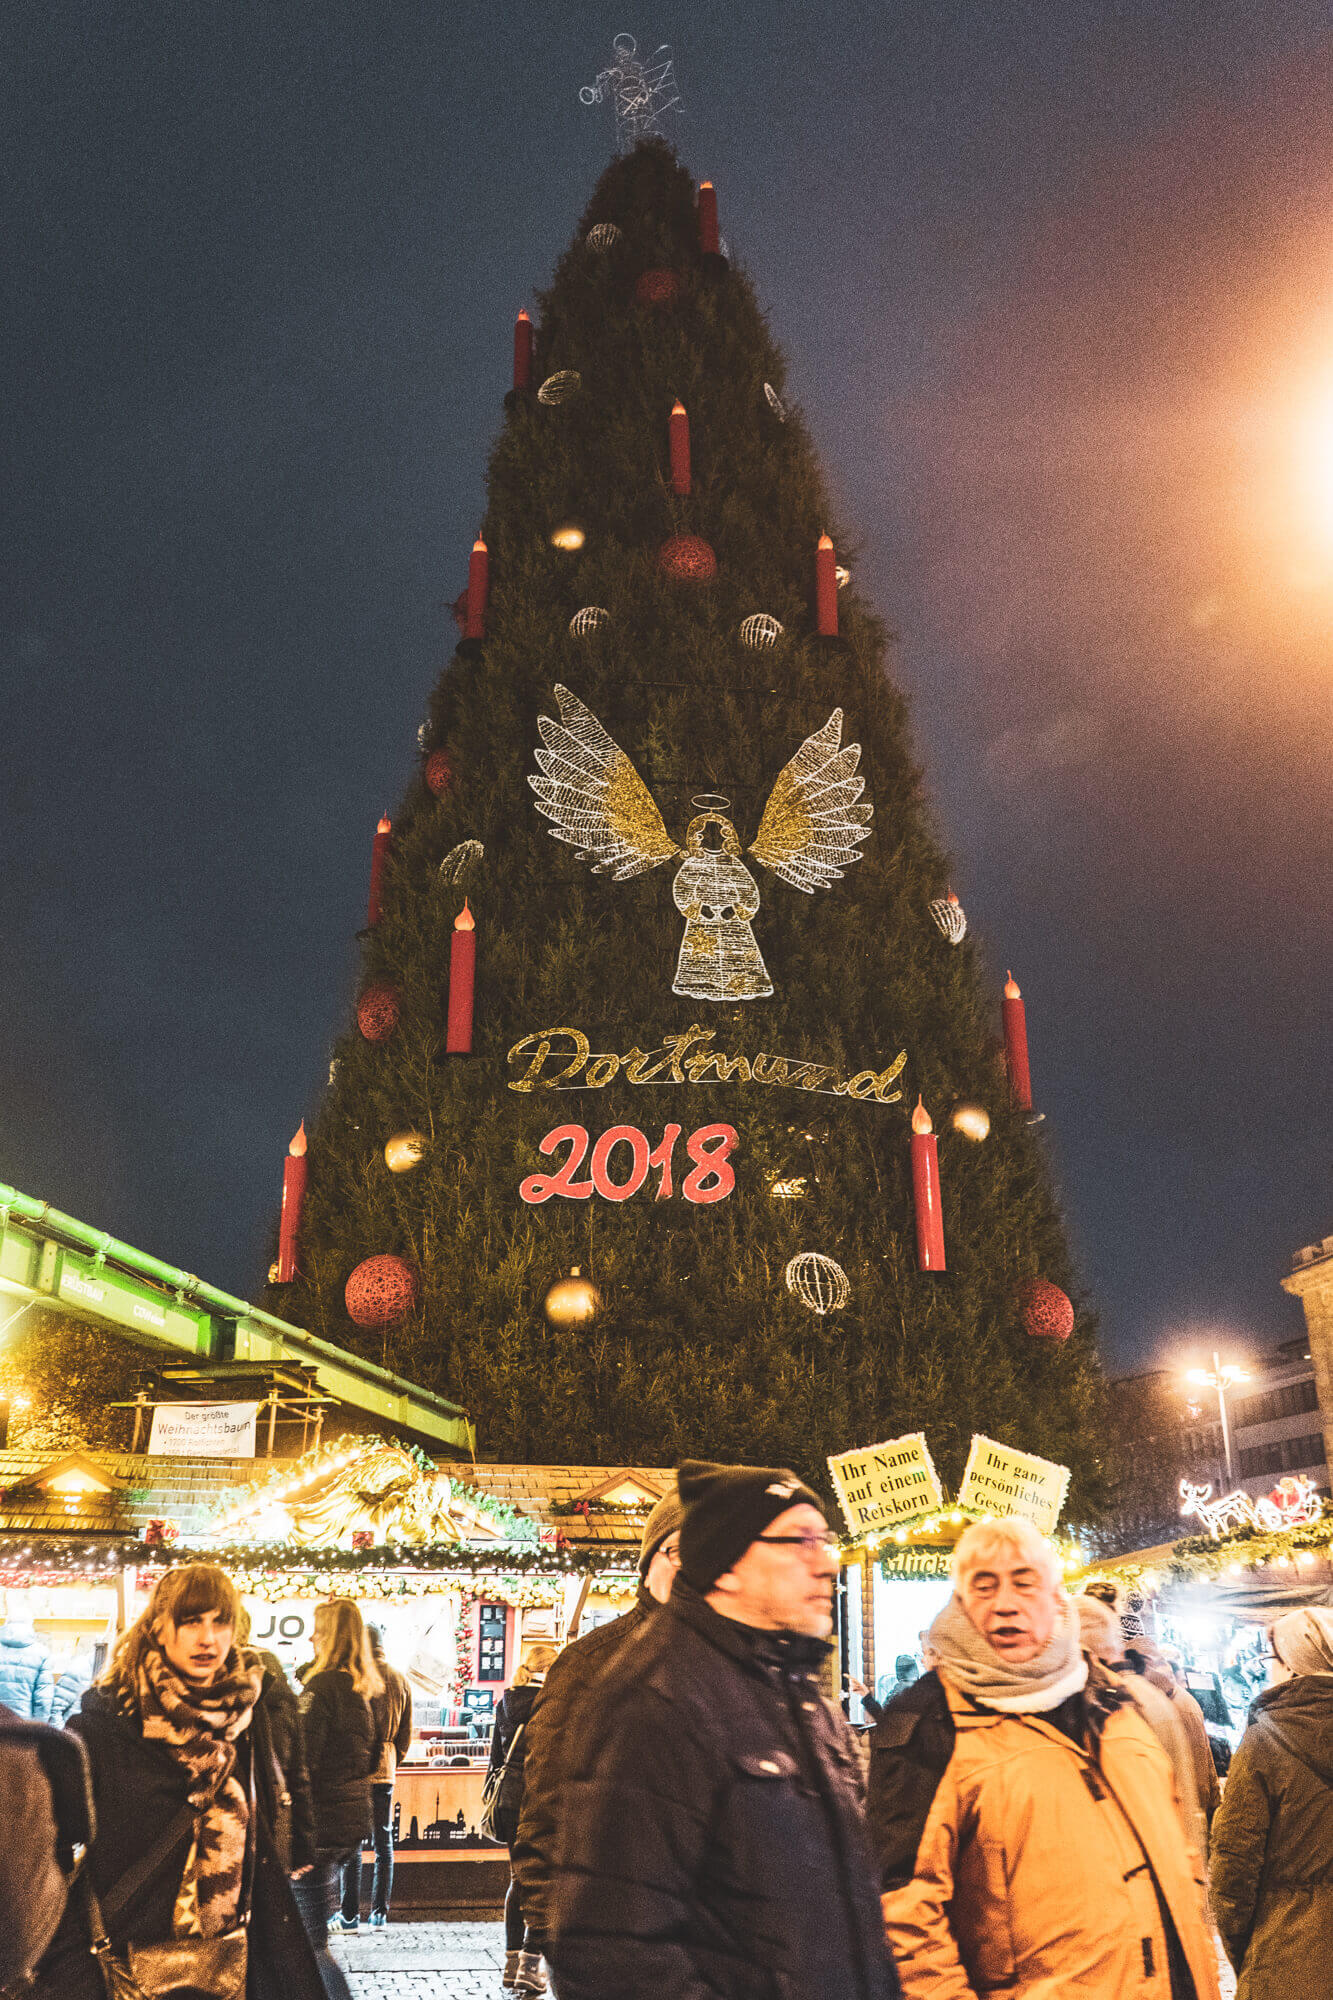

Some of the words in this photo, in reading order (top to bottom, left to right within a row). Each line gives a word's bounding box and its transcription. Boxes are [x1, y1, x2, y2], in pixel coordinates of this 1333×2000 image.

[507, 1023, 907, 1104] Dortmund
[519, 1123, 740, 1204] 2018
[158, 1421, 251, 1435] Weihnachtsbaum
[185, 1411, 200, 1421] Der
[201, 1410, 230, 1422] größte
[840, 1463, 867, 1481] Ihr
[873, 1449, 920, 1472] Name
[986, 1453, 1009, 1472] Ihr
[1013, 1466, 1046, 1487] ganz
[847, 1481, 873, 1503] auf
[880, 1471, 927, 1494] einem
[970, 1471, 1053, 1510] persönliches
[857, 1493, 930, 1524] Reiskorn
